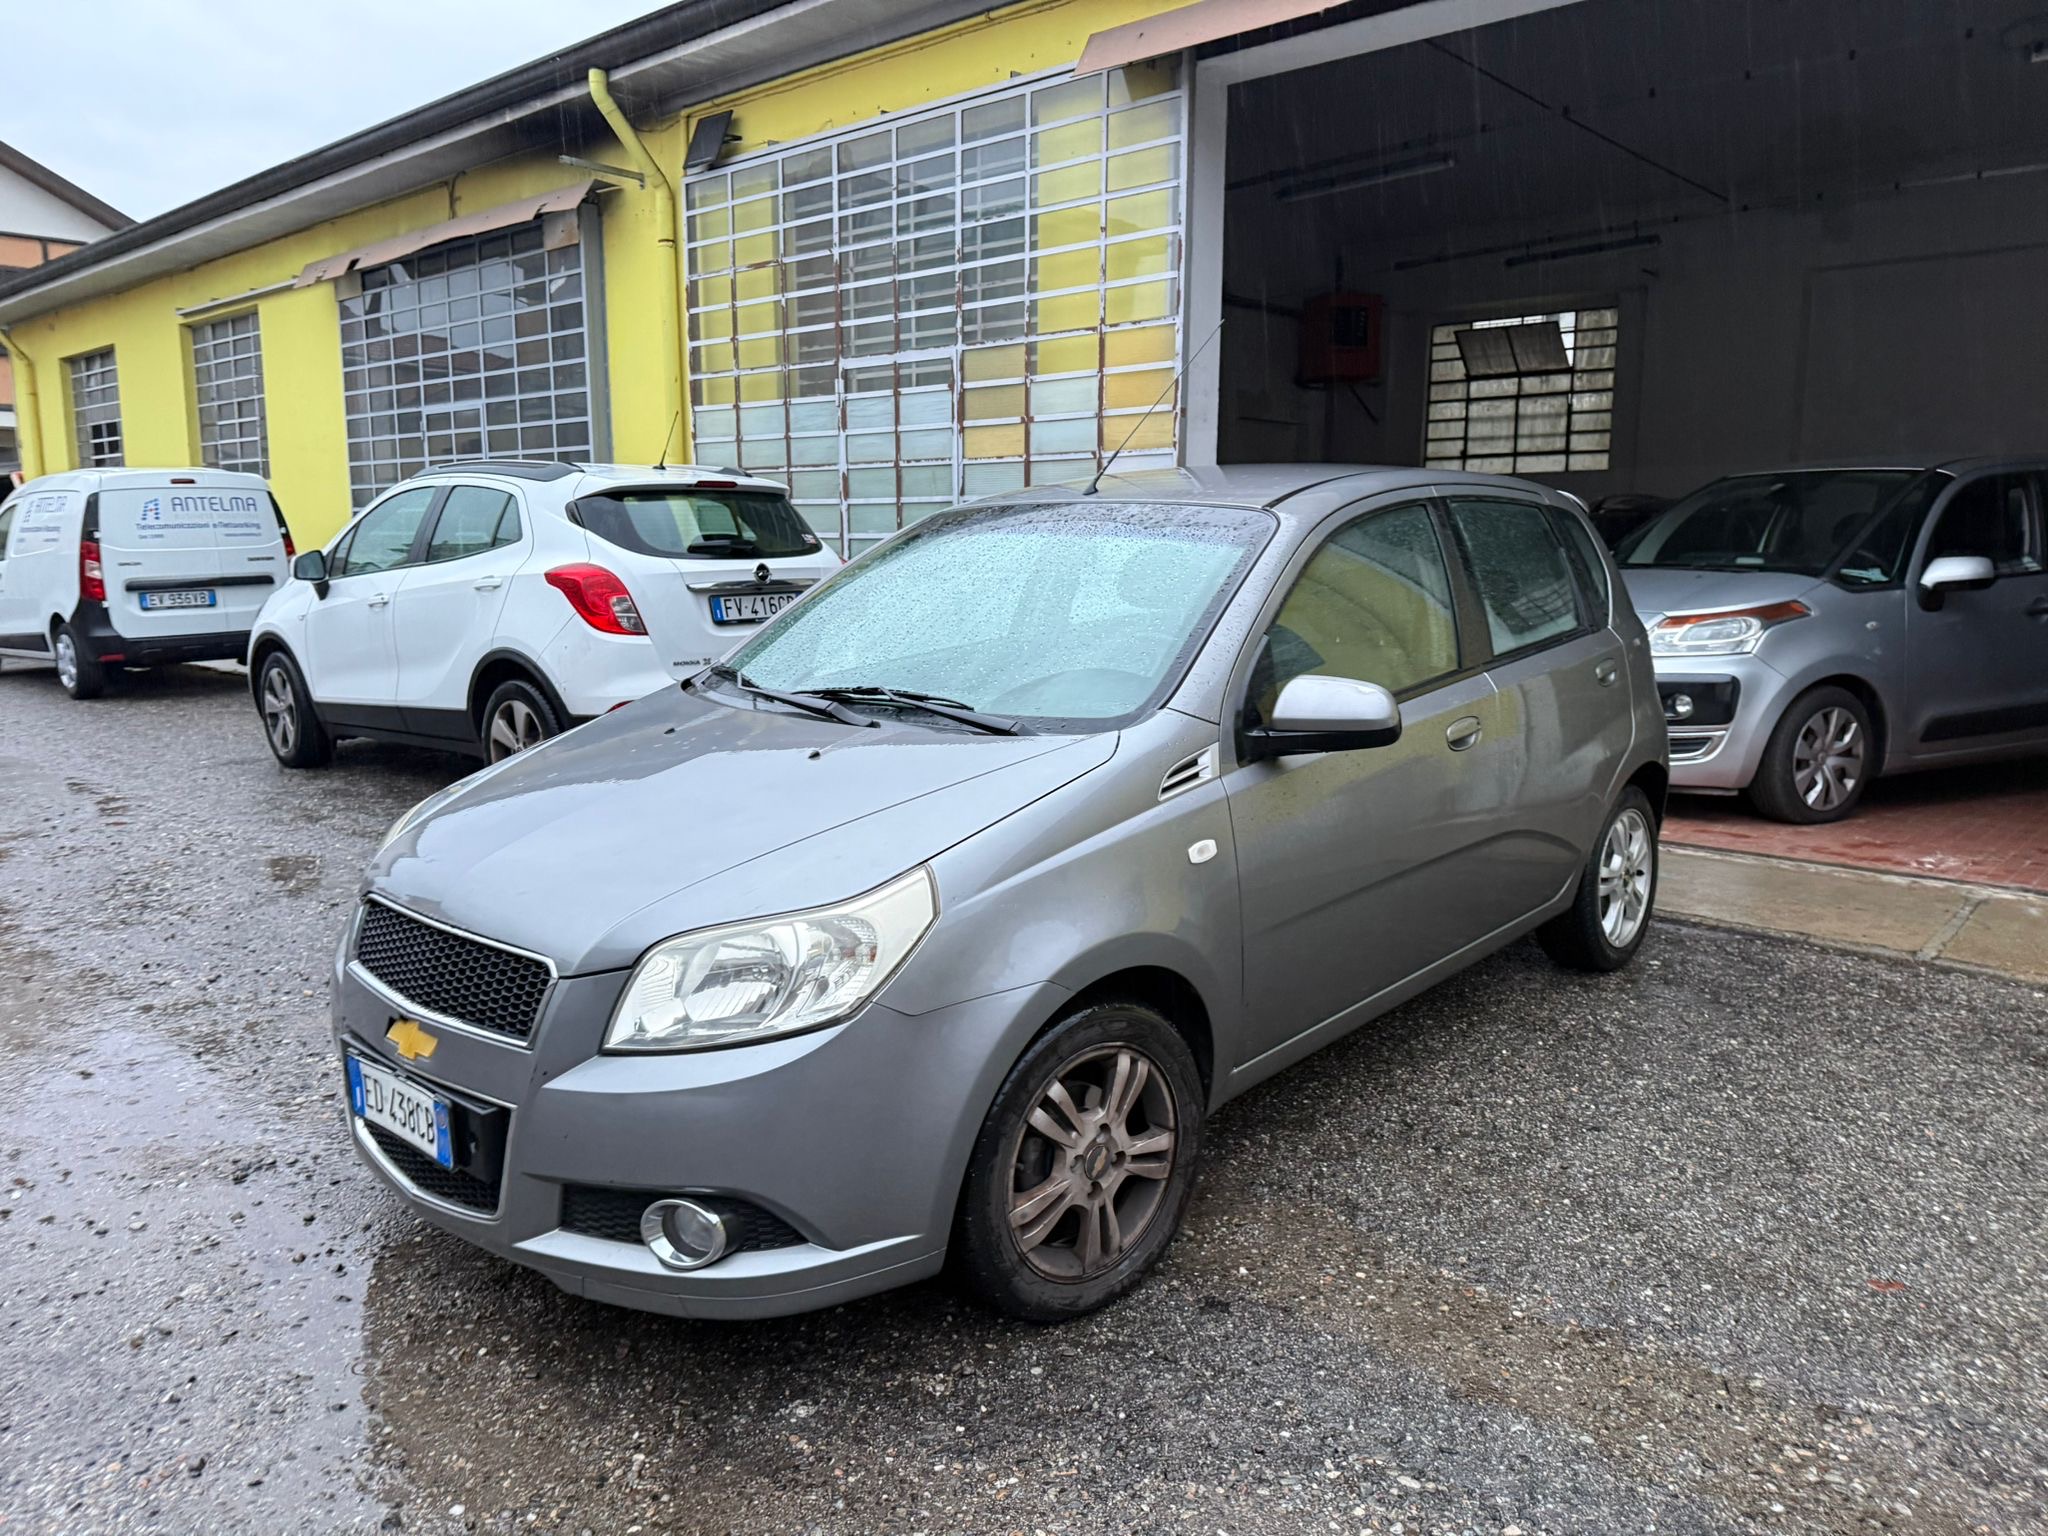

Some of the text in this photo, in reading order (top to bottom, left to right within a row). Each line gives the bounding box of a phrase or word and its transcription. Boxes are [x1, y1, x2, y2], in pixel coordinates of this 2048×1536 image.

[171, 496, 257, 512] ANTELMA
[150, 594, 165, 606] EV
[723, 598, 742, 618] FV
[363, 1073, 384, 1114] ED
[389, 1087, 435, 1144] 438CB
